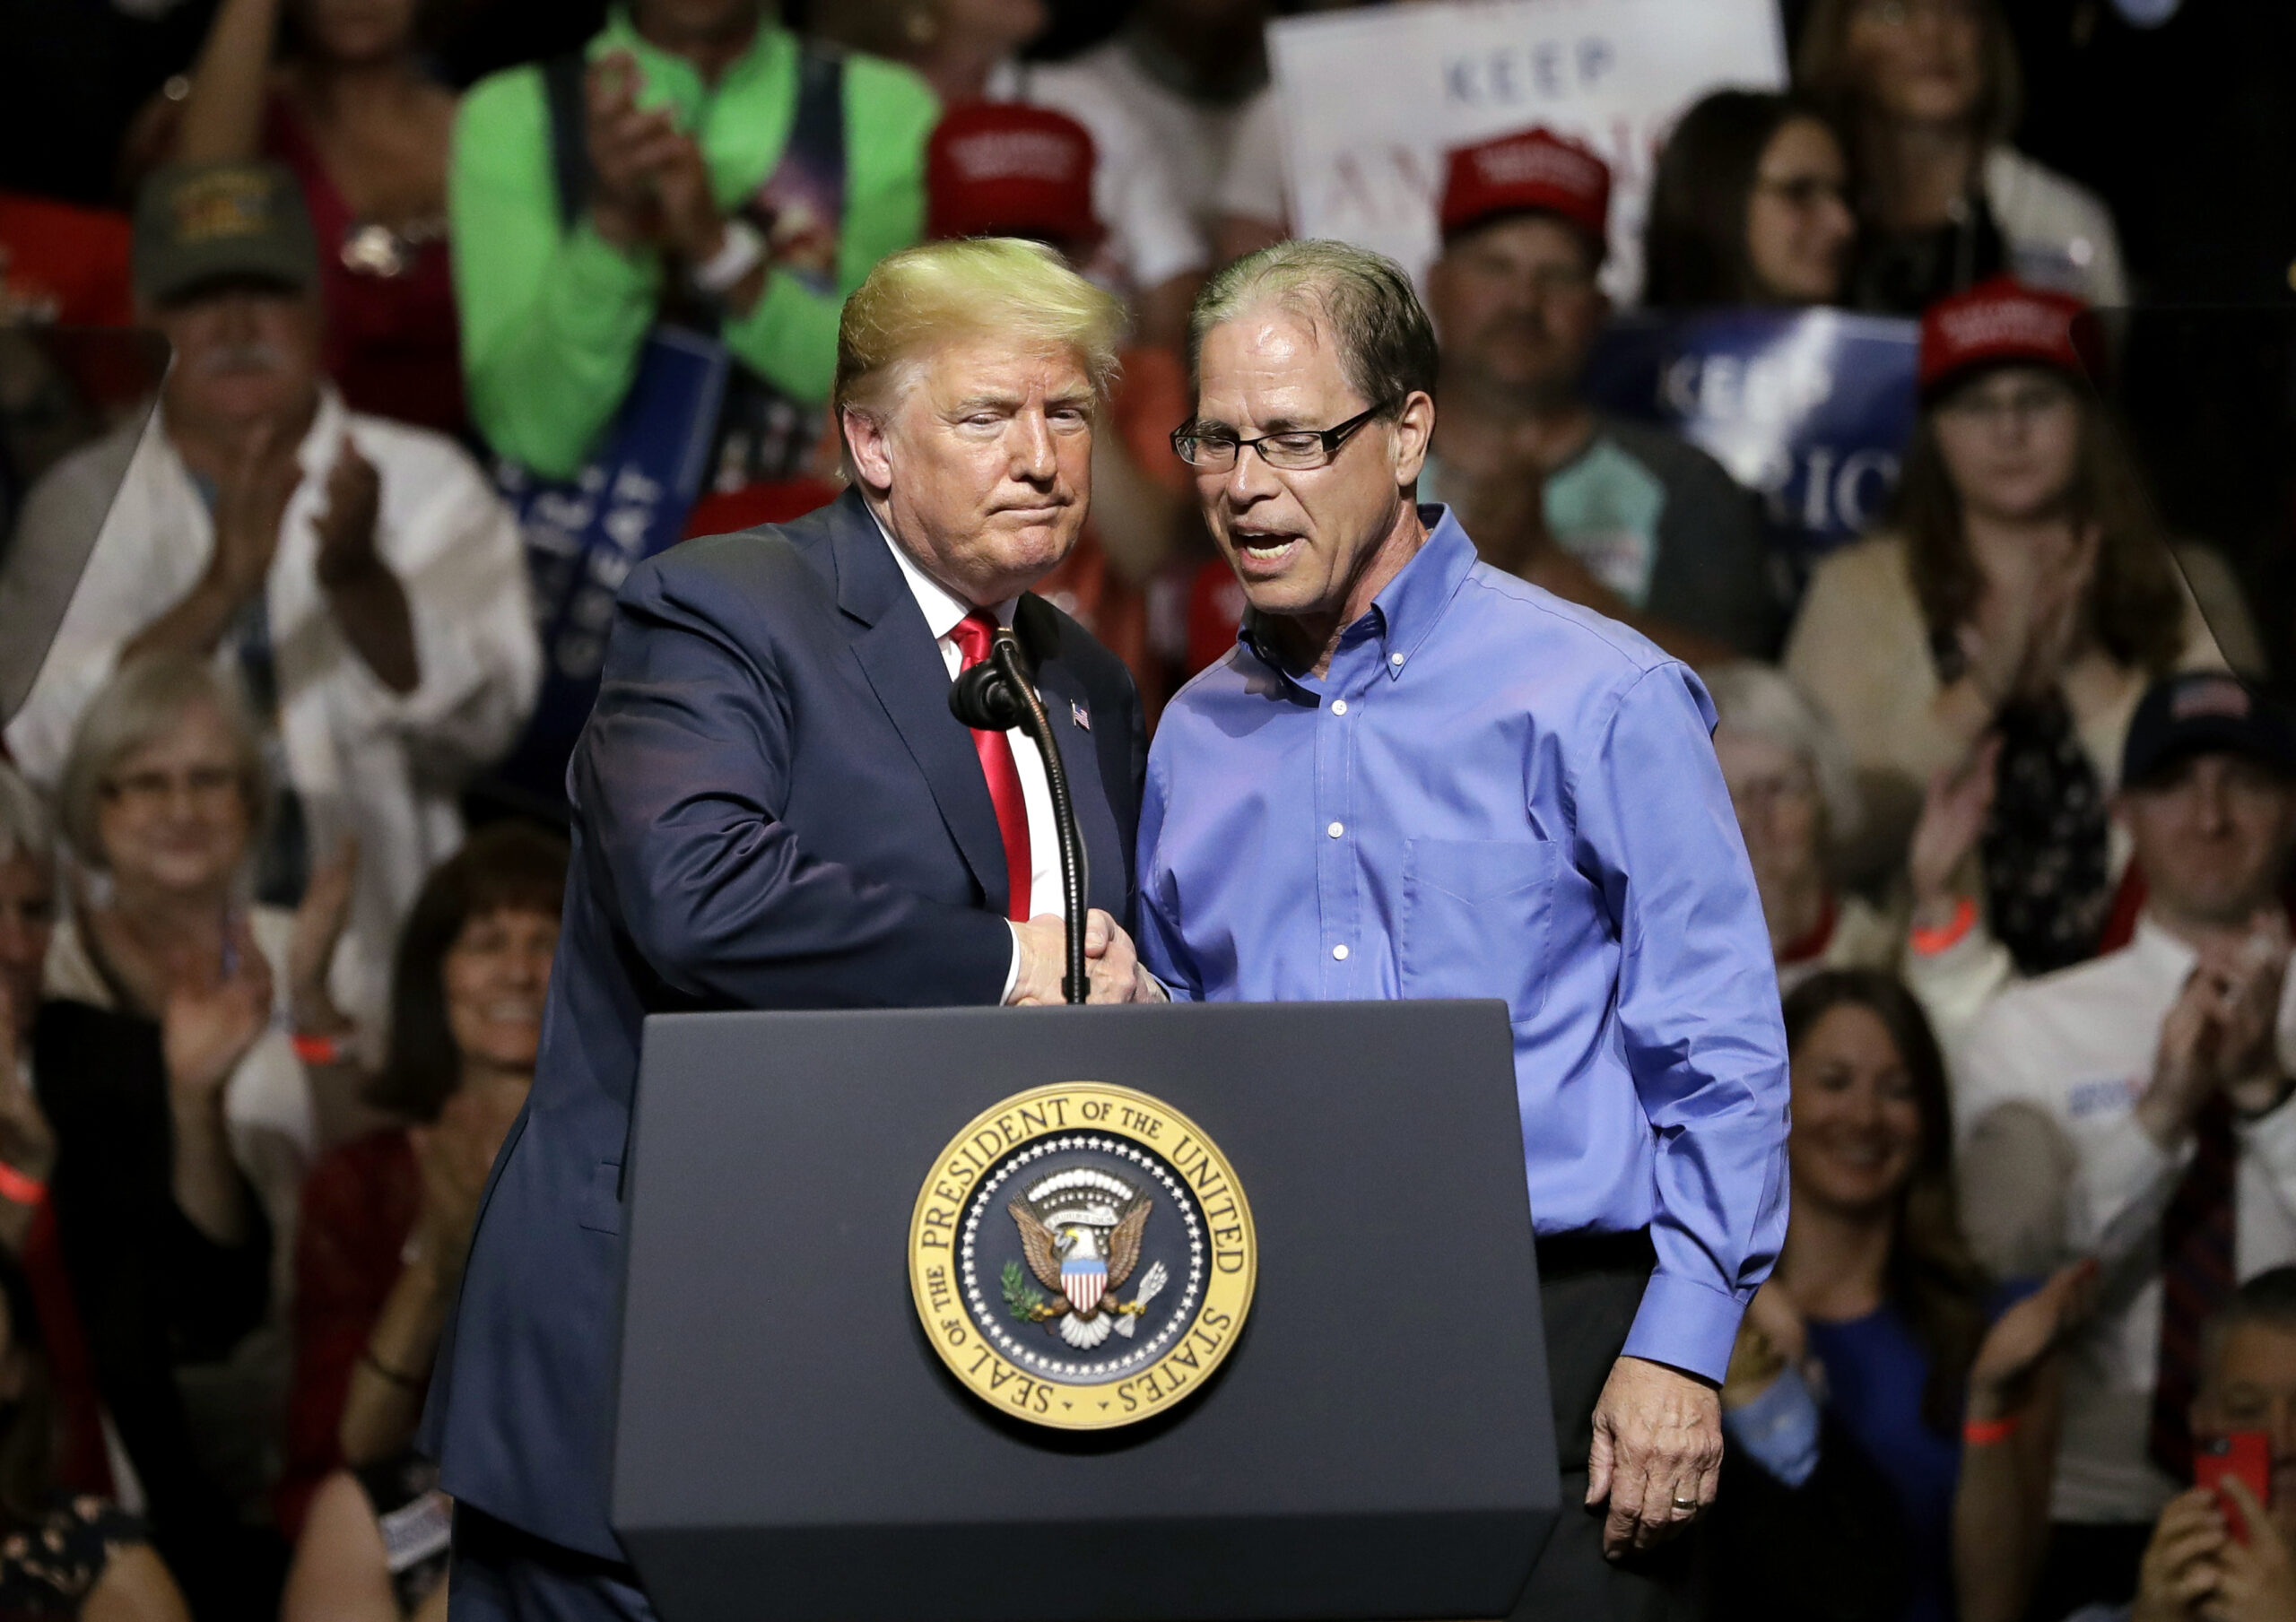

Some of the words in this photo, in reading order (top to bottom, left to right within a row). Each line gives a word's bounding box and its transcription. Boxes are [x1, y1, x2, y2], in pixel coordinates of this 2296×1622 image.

[1441, 37, 1613, 103] KEEP
[1082, 1101, 1113, 1121] OF
[1121, 1107, 1163, 1141] THE
[921, 1097, 1070, 1250] PRESIDENT
[1172, 1135, 1245, 1274] UNITED
[926, 1265, 952, 1313] THE
[941, 1318, 967, 1347] OF
[1118, 1307, 1231, 1412] STATES
[968, 1344, 1054, 1414] SEAL
